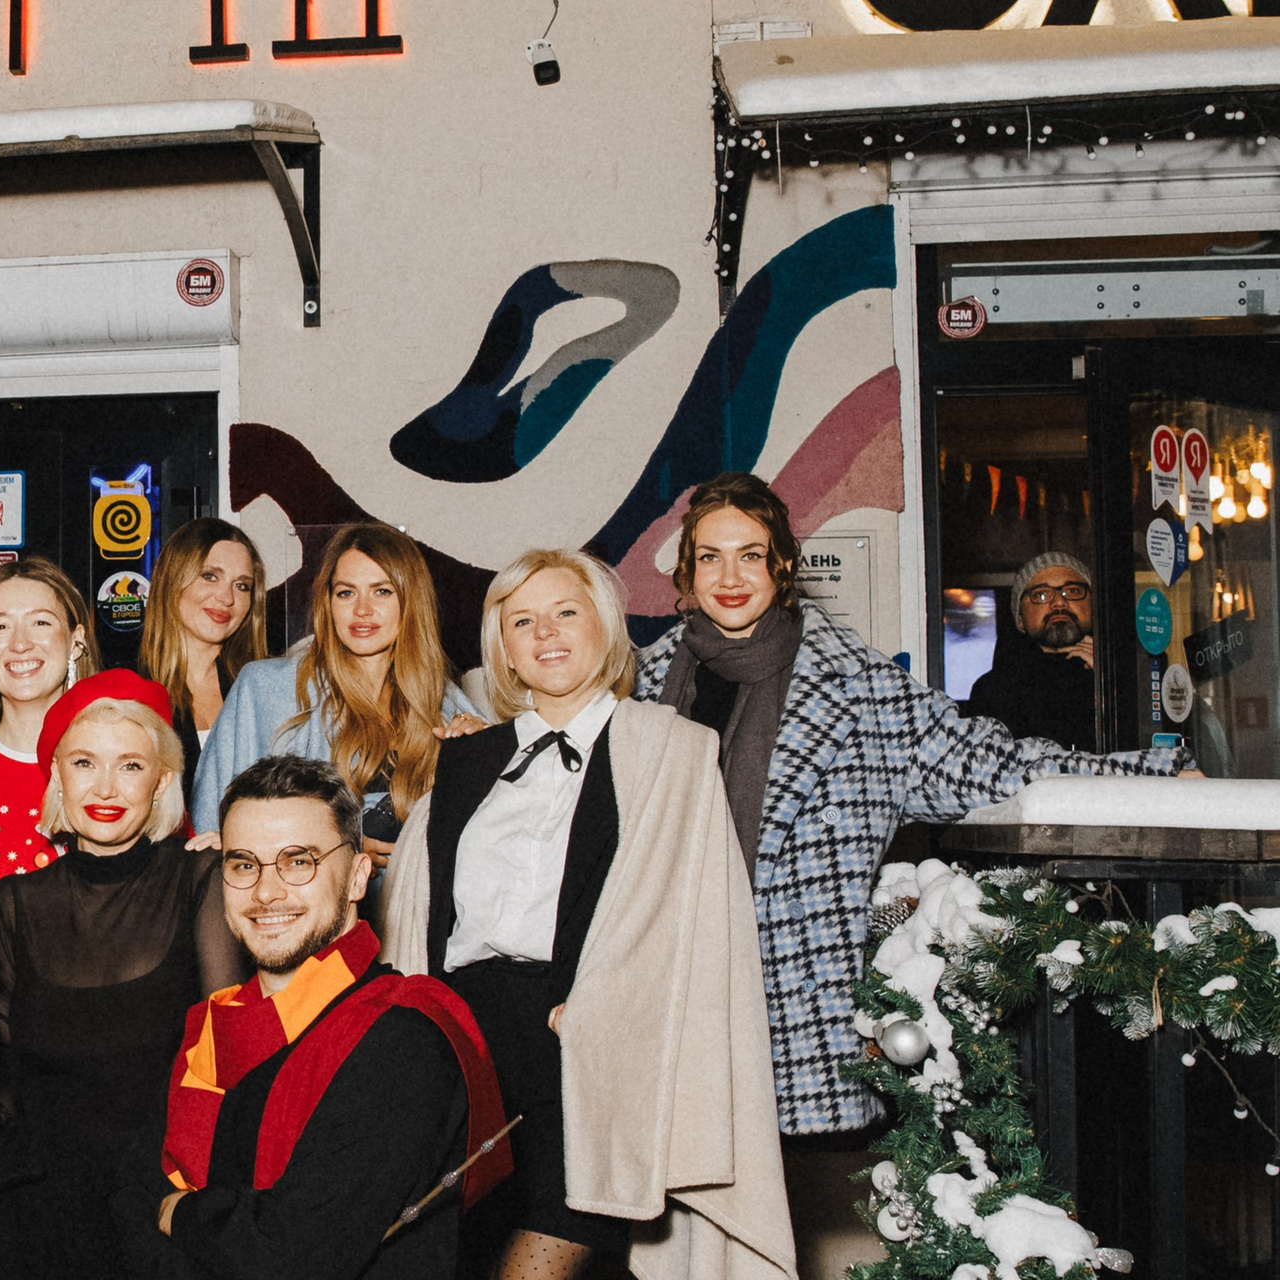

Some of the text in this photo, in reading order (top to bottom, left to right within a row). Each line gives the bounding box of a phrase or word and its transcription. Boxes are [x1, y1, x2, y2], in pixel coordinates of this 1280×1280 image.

[190, 275, 211, 287] БМ
[951, 310, 972, 321] БМ
[1160, 438, 1170, 465] Я
[1190, 441, 1200, 468] Я
[801, 554, 842, 568] ЛЕНЬ
[1195, 630, 1244, 667] ОТКРЫТО
